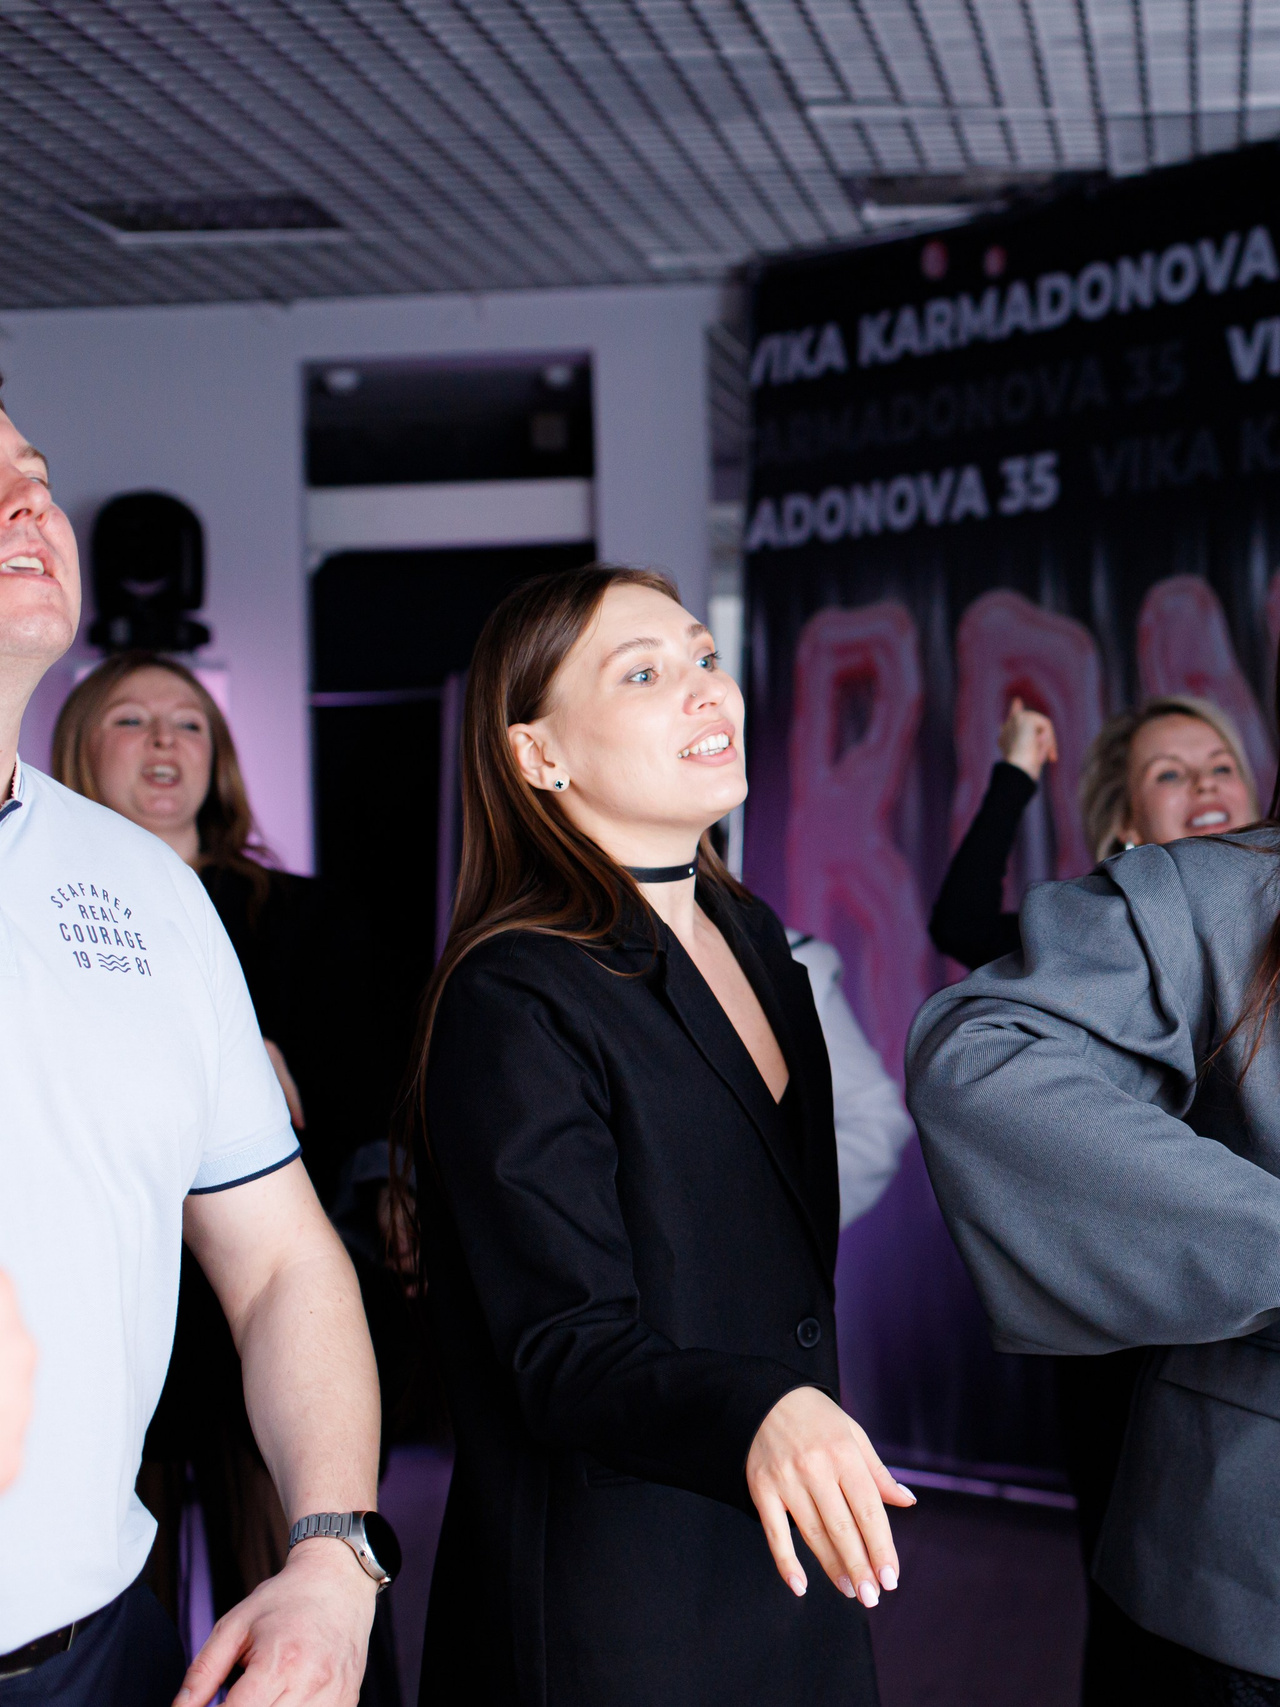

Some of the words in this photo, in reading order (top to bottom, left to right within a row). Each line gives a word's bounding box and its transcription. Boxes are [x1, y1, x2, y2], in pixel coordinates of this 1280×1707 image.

[1122, 340, 1187, 405] 35
[1091, 424, 1224, 499] VIKA
[998, 448, 1062, 517] 35
[50, 882, 132, 920] SEAFARER
[78, 904, 119, 924] REAL
[59, 922, 147, 951] COURAGE
[72, 950, 92, 969] 19
[135, 956, 152, 977] 81
